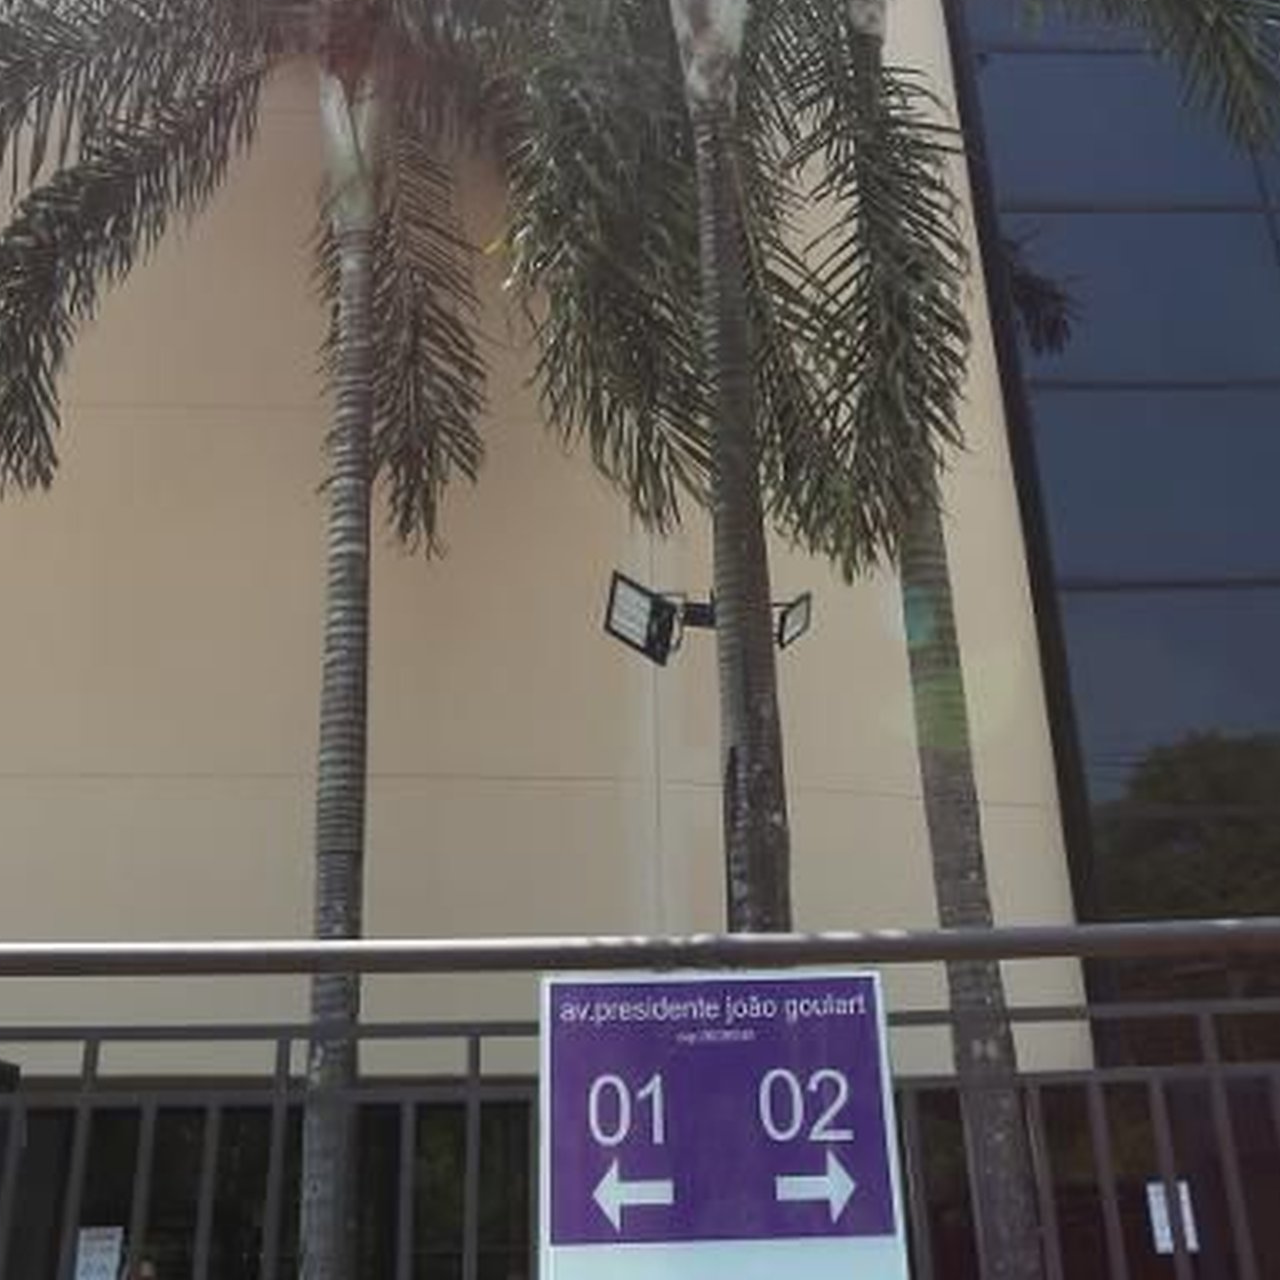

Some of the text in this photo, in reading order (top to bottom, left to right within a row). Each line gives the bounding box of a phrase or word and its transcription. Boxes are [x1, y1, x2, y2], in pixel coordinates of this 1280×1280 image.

[724, 994, 777, 1024] joão
[786, 992, 867, 1022] goulart
[589, 1068, 854, 1146] 01 02
